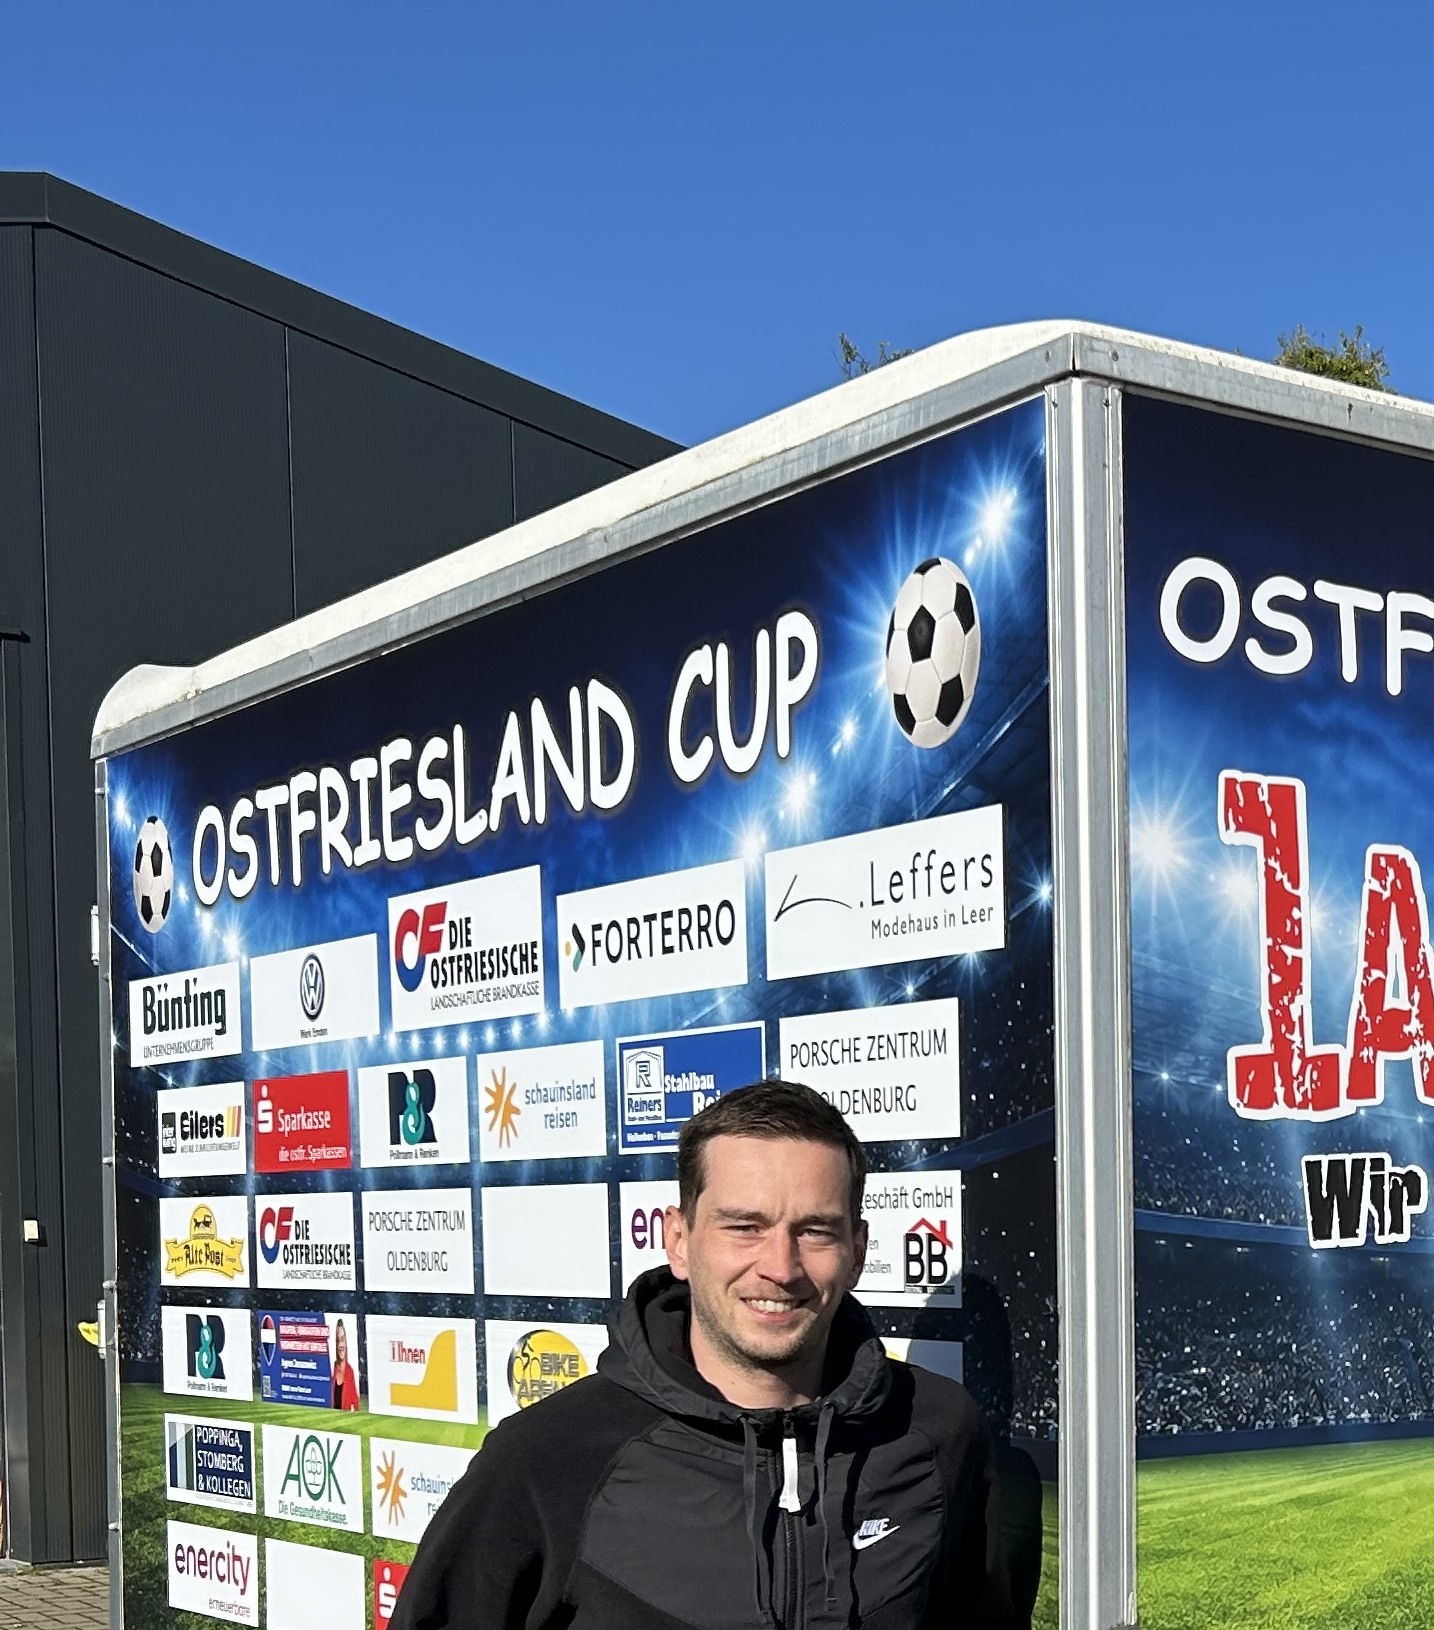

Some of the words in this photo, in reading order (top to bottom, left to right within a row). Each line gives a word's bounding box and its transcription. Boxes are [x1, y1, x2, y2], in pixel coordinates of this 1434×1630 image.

[192, 677, 636, 905] OSTFRIESLAND
[668, 610, 819, 783] CUP
[448, 916, 472, 950] DIE
[591, 900, 736, 967] FORTERRO
[871, 914, 939, 940] Modehaus
[943, 909, 956, 929] in
[961, 905, 994, 925] Leer
[430, 940, 539, 989] OSTFRIESISCHE
[142, 977, 227, 1036] Bünting
[790, 1036, 862, 1069] PORSCHE
[867, 1028, 948, 1061] ZENTRUM
[524, 1077, 597, 1106] schauinsland
[664, 1072, 715, 1094] Stahlbau
[543, 1106, 578, 1130] reisen
[627, 1097, 662, 1114] Reiners
[180, 1109, 225, 1141] Eilers
[278, 1105, 332, 1137] Sparkasse
[861, 1185, 910, 1214] eschäft
[912, 1184, 954, 1209] GmbH
[1305, 1155, 1425, 1247] Wir
[294, 1220, 311, 1241] DIE
[368, 1210, 413, 1232] PORSCHE
[415, 1210, 466, 1232] ZENTRUM
[184, 1243, 204, 1270] Alte
[204, 1242, 225, 1268] Post
[282, 1244, 352, 1266] OSTFRIESISCHE
[386, 1250, 448, 1272] OLDENBURG
[540, 1352, 580, 1378] BIKE
[517, 1378, 566, 1402] ARE
[196, 1426, 243, 1453] POPPINGA,
[196, 1450, 245, 1473] STOMBERG
[280, 1434, 346, 1505] AOK
[198, 1473, 205, 1491] &
[206, 1474, 251, 1498] KOLLEGEN
[174, 1540, 251, 1596] enercity
